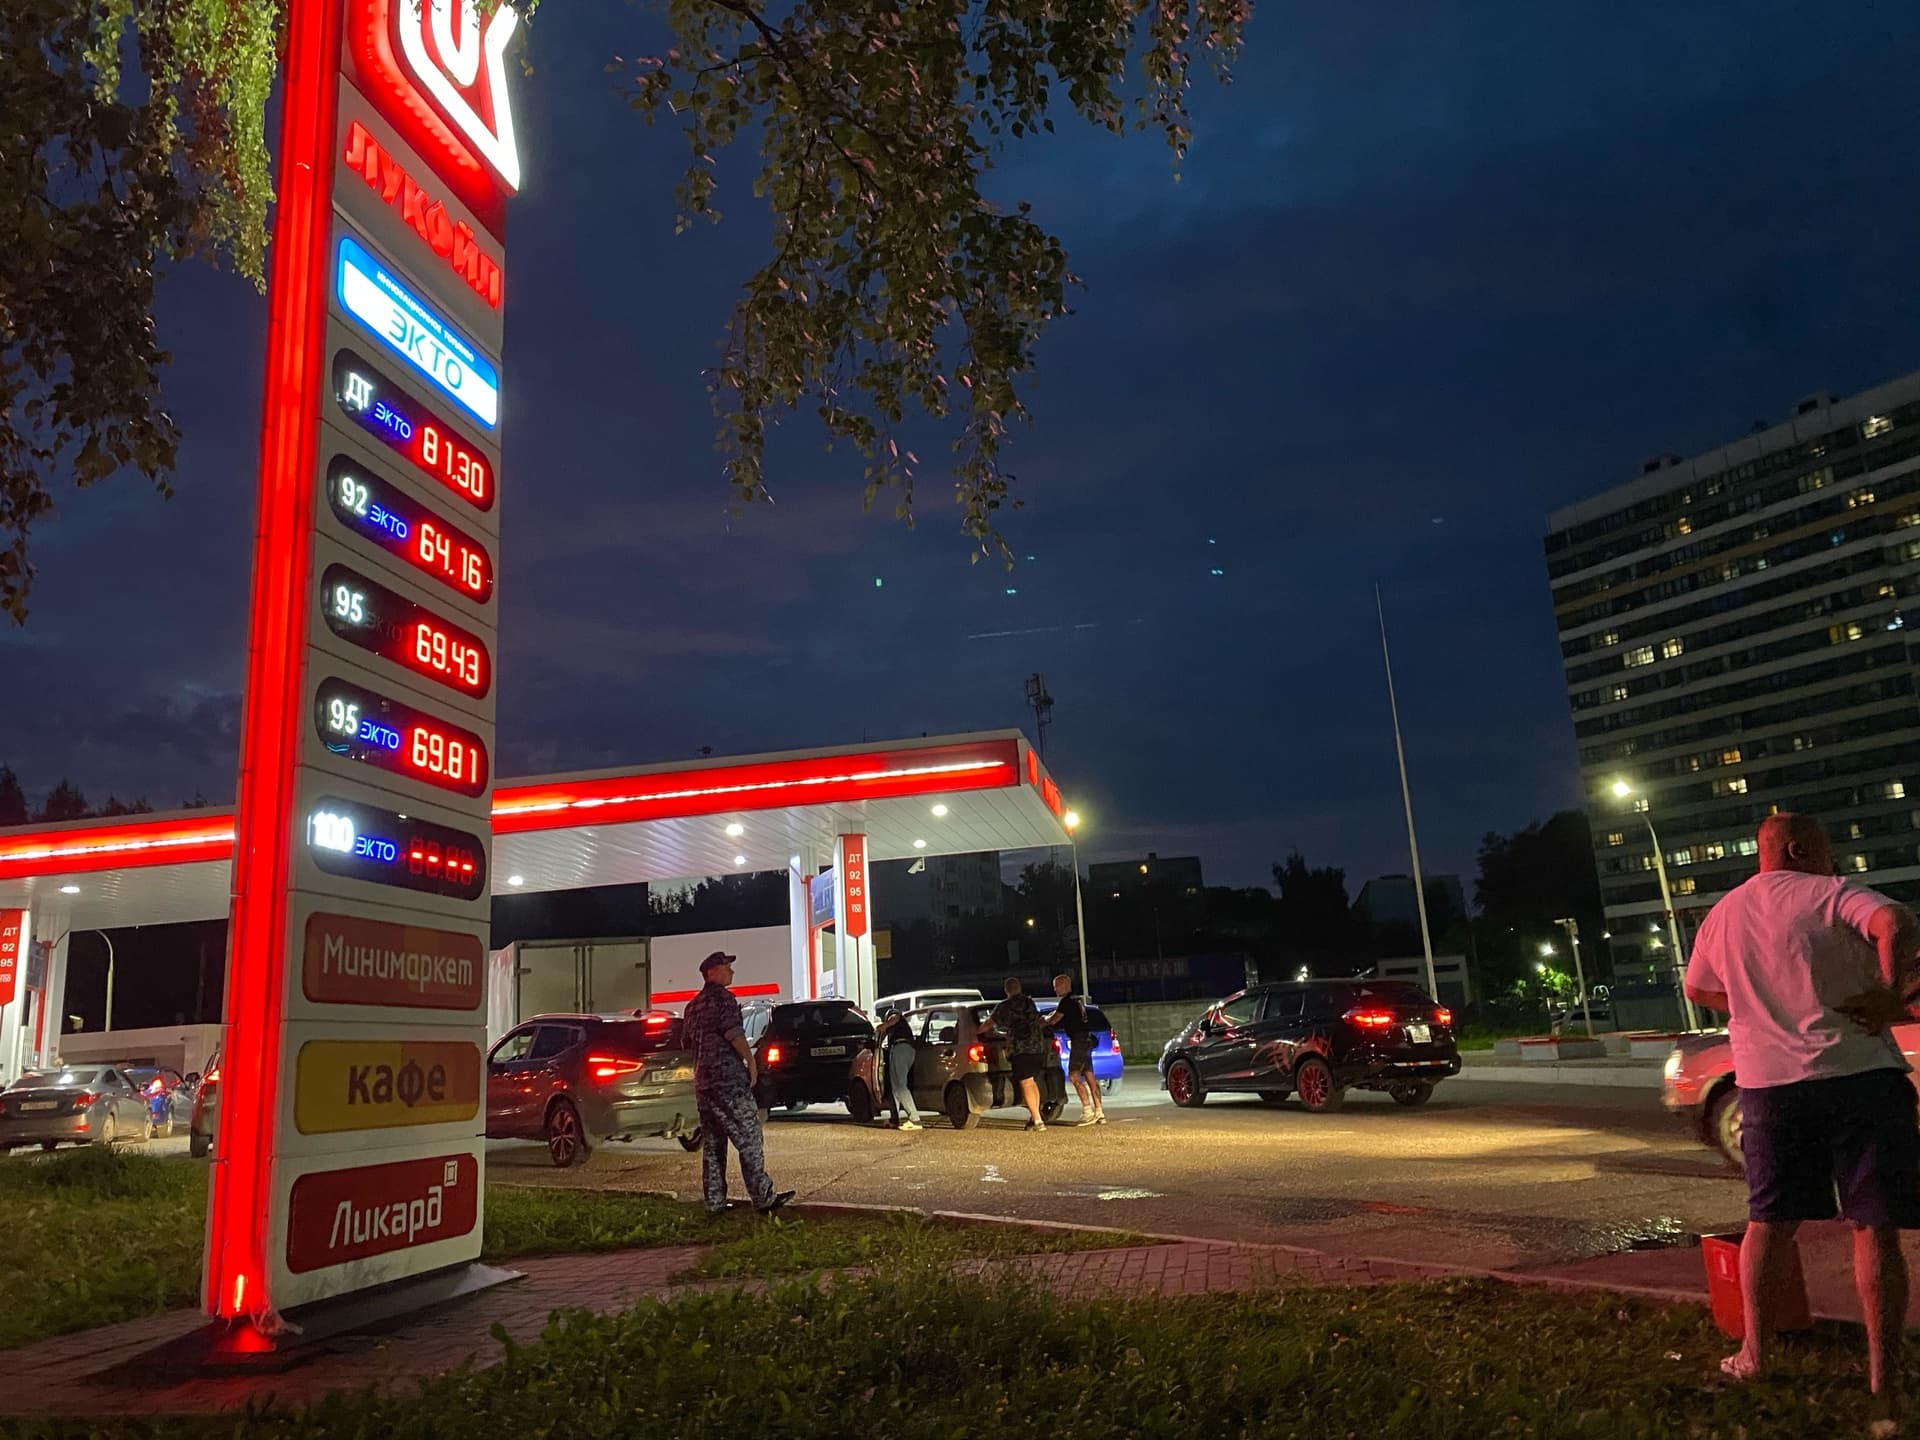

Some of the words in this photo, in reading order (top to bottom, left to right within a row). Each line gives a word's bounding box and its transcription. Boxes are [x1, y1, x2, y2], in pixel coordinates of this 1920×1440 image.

[344, 120, 501, 309] ЛУКОЙЛ
[388, 308, 463, 390] ЭКТО
[345, 371, 375, 411] ДТ
[374, 402, 411, 439] ЭКТО
[423, 426, 484, 498] 81.30
[341, 476, 369, 516] 92
[370, 504, 408, 539] ЭКТО
[419, 523, 482, 591] 64.16
[335, 585, 364, 623] 95
[416, 623, 479, 686] 69.43
[330, 698, 359, 735] 95
[360, 720, 400, 750] ЭКТО
[412, 728, 478, 784] 69.81
[355, 836, 396, 861] ЭКТО
[848, 853, 861, 864] ДТ
[849, 870, 861, 881] 92
[849, 887, 862, 897] 95
[2, 943, 15, 952] 92
[3, 927, 18, 937] ДТ
[0, 958, 13, 968] 95
[323, 933, 473, 993] Минимаркет
[347, 1059, 448, 1108] кафе
[328, 1185, 442, 1249] Ликард
